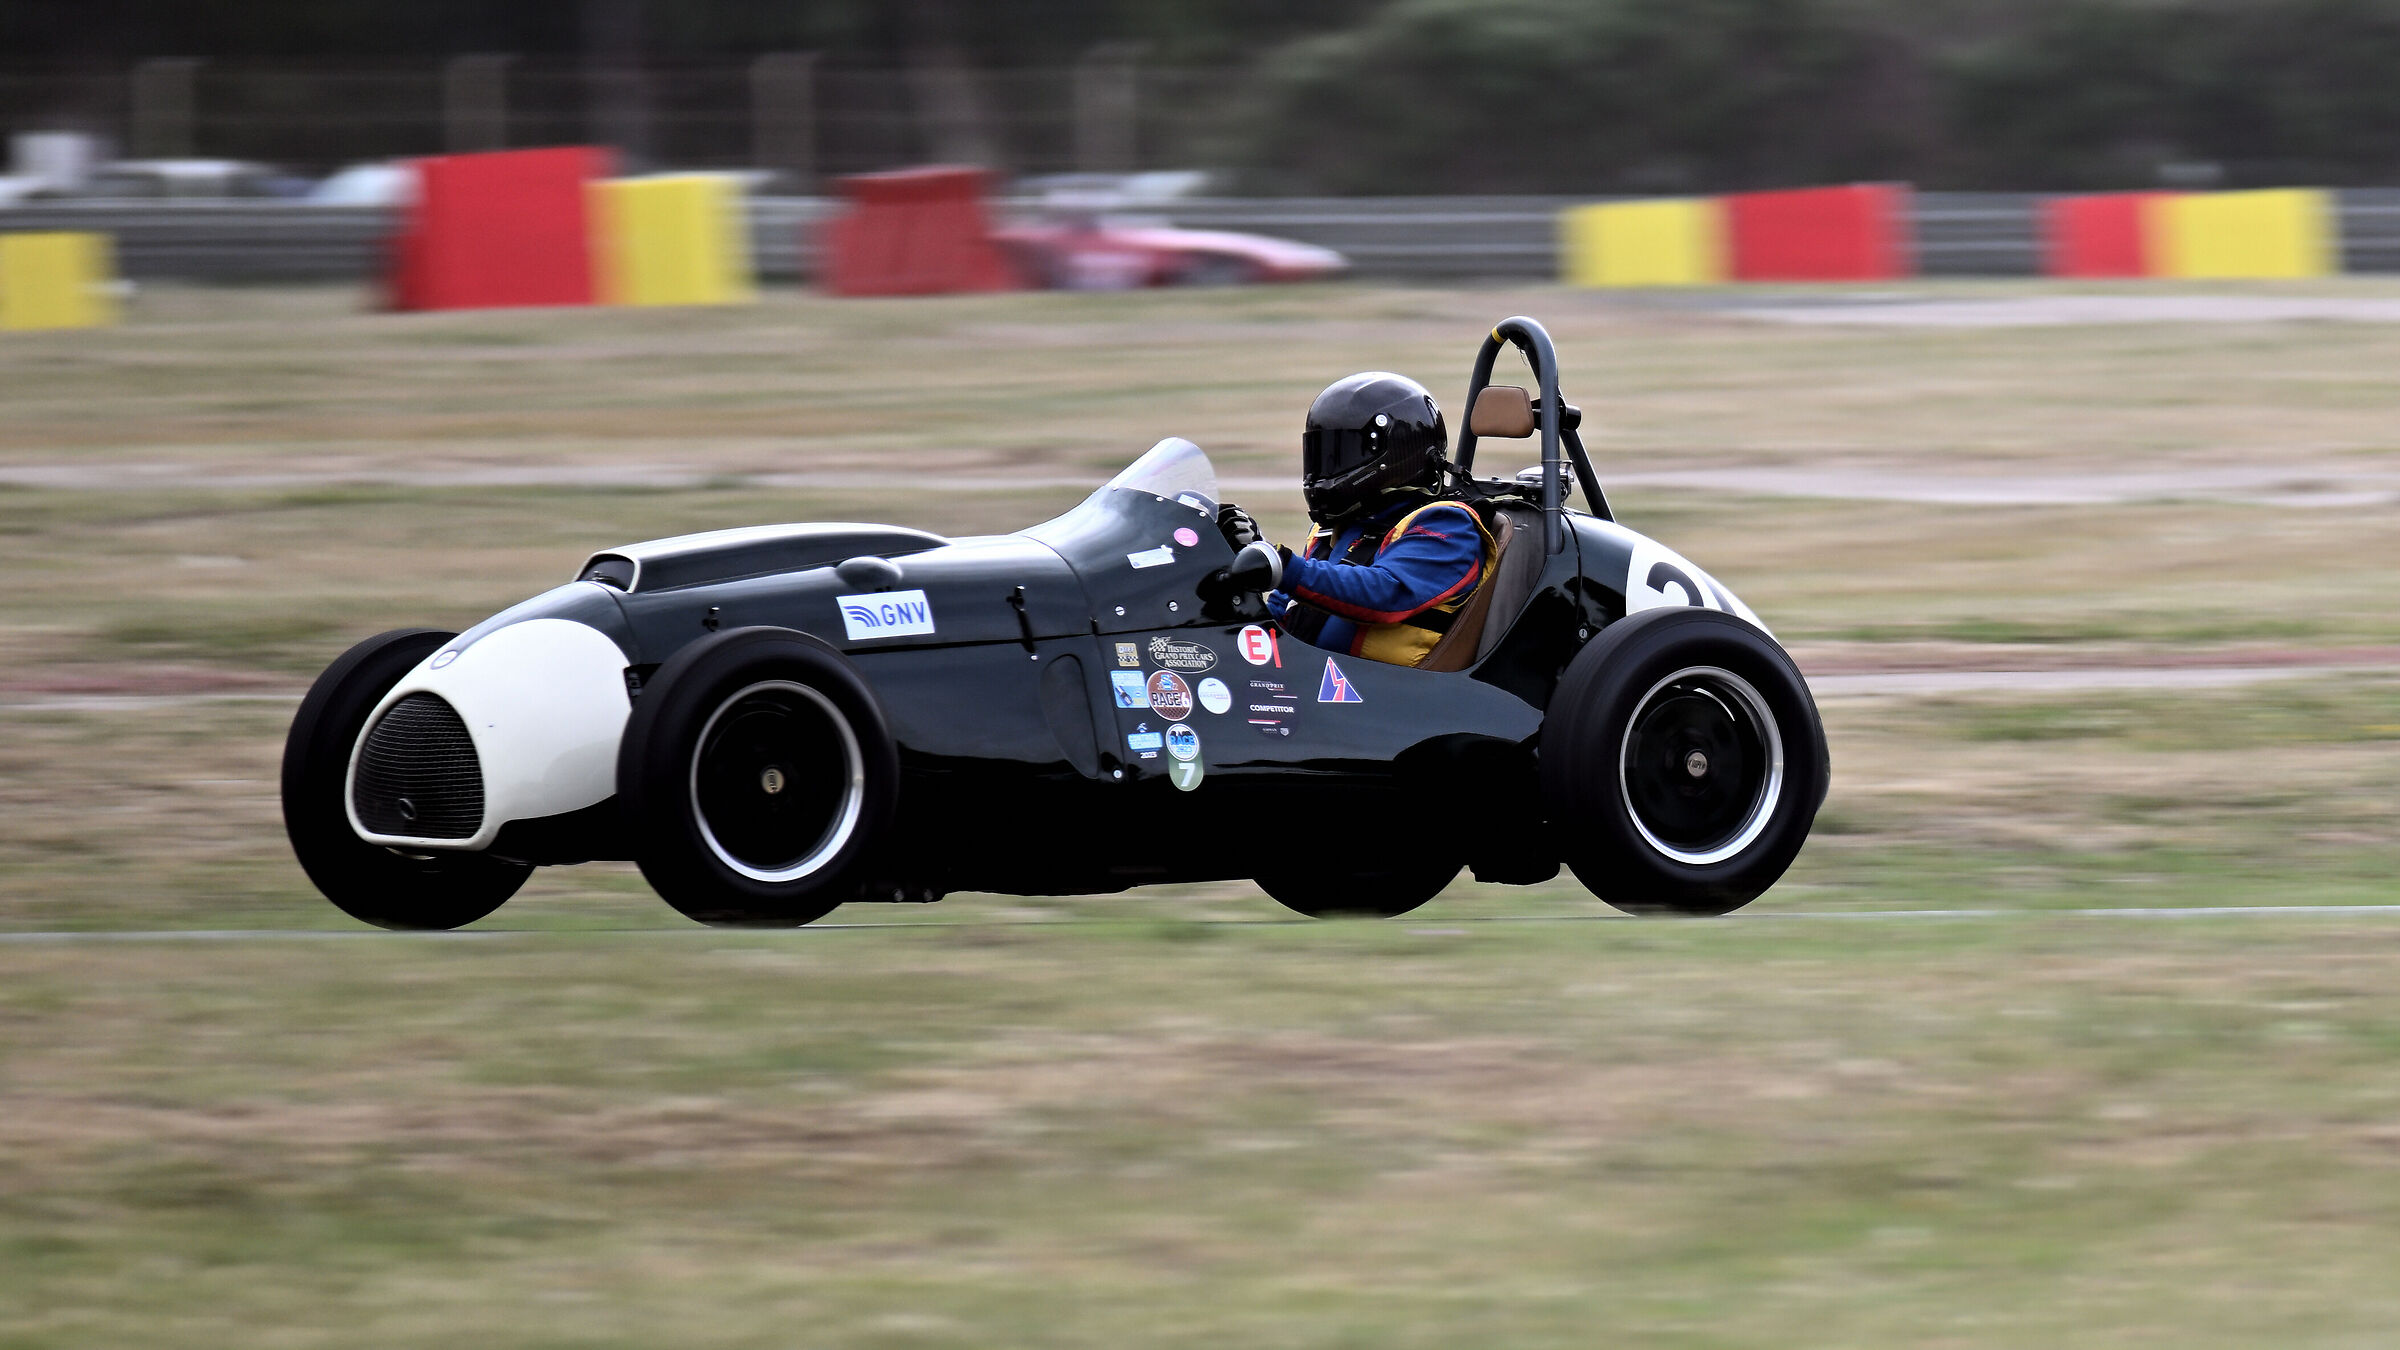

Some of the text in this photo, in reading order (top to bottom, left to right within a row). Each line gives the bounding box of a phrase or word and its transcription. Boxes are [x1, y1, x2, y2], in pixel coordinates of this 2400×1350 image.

[881, 601, 925, 626] GNV
[1167, 645, 1199, 653] HISTORIC
[1154, 651, 1178, 660] GRAND
[1195, 653, 1214, 661] CARS
[1164, 660, 1207, 668] ASSOCIATION
[1250, 704, 1294, 713] COMPETITOR
[1178, 762, 1196, 787] 7
